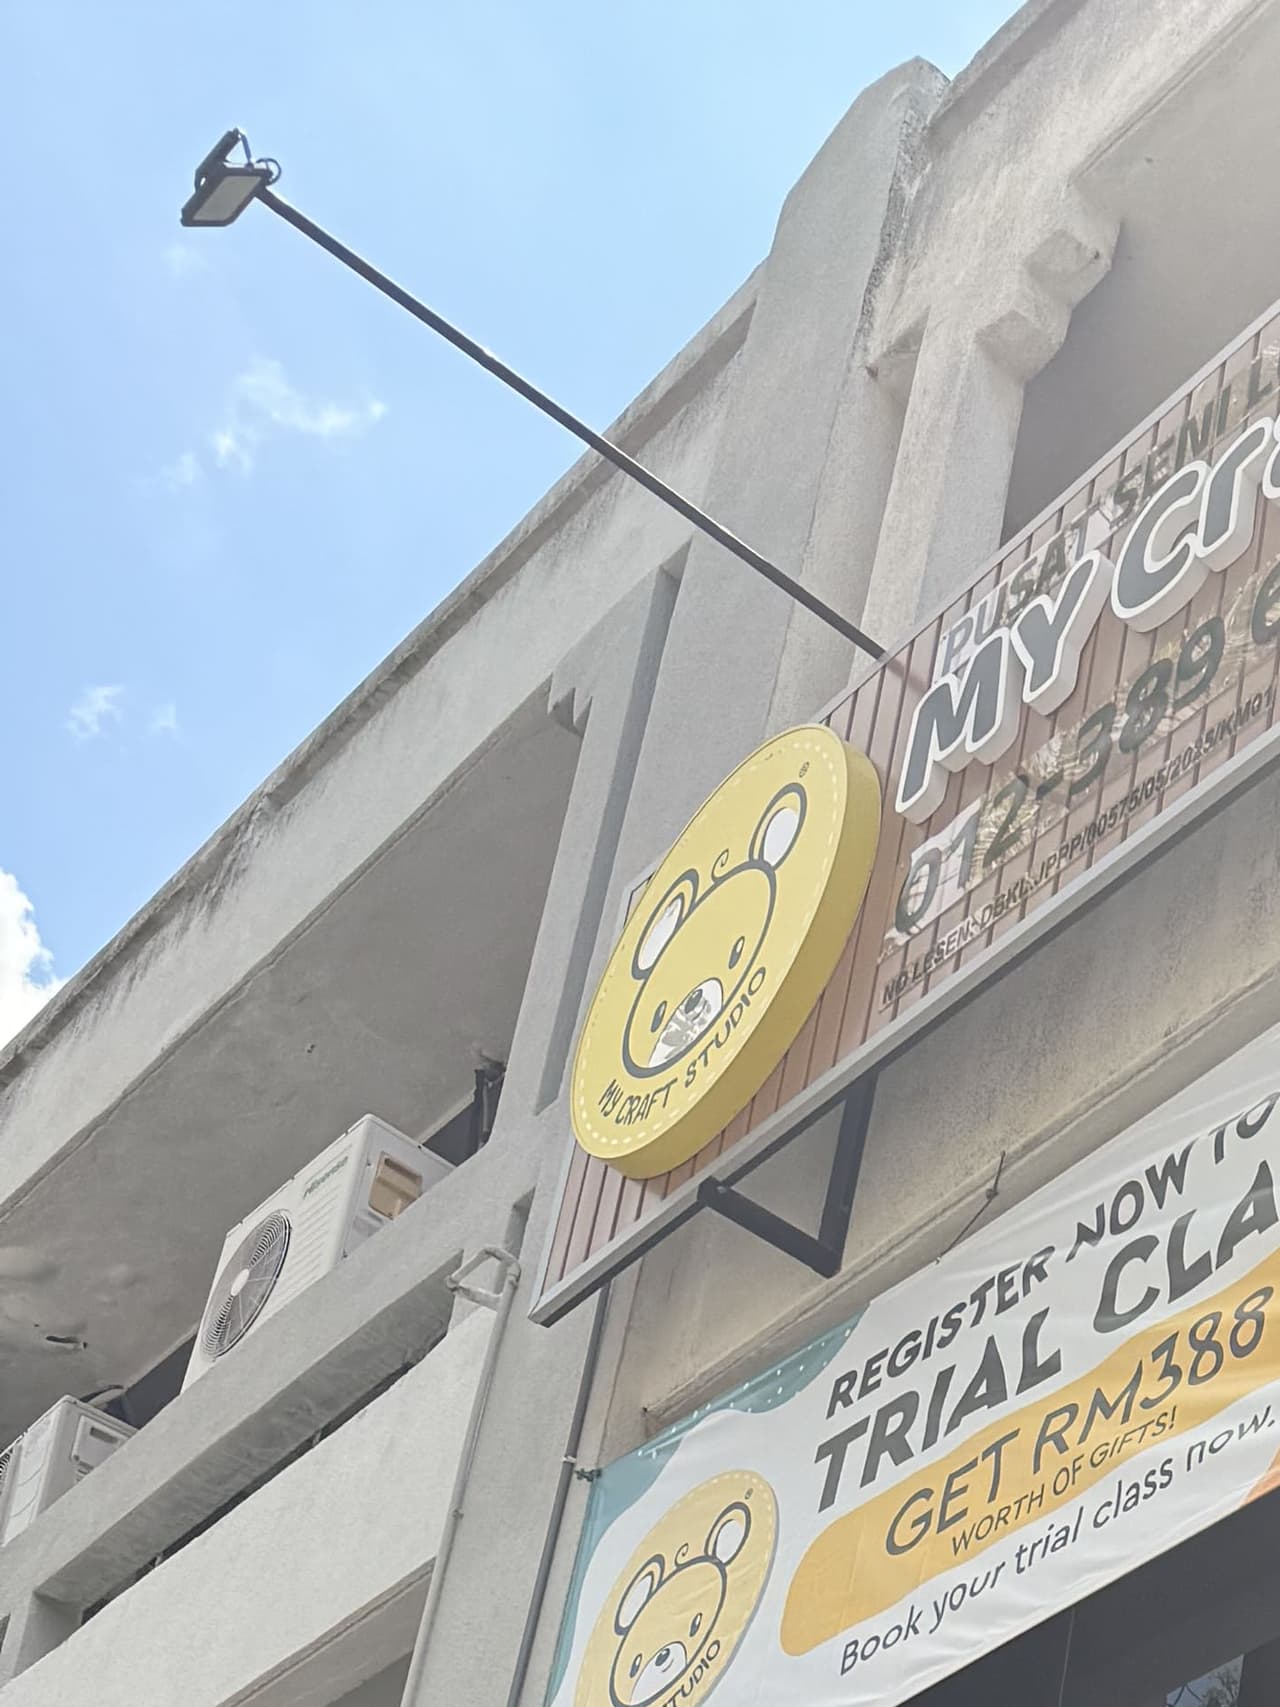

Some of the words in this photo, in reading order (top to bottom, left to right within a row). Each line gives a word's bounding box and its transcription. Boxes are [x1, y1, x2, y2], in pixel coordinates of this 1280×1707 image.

[942, 508, 1095, 674] PUSAT
[1108, 387, 1228, 528] SENI
[895, 617, 1225, 934] 012-389
[896, 550, 1112, 822] MY
[598, 1078, 617, 1115] MY
[615, 1080, 678, 1125] CRAFT
[685, 966, 766, 1088] STUDIO
[810, 1327, 1064, 1511] TRIAL
[824, 1237, 1059, 1417] REGISTER
[1069, 1151, 1207, 1251] NOW
[840, 1612, 922, 1675] Book
[927, 1565, 1004, 1632] your
[1013, 1507, 1082, 1575] trial
[1091, 1458, 1174, 1530] class
[1181, 1405, 1277, 1476] now.
[884, 1448, 1006, 1558] GET
[1031, 1284, 1276, 1468] RM388
[951, 1478, 1047, 1558] WORTH
[1051, 1460, 1086, 1507] OF
[1088, 1405, 1178, 1476] GIFTS!
